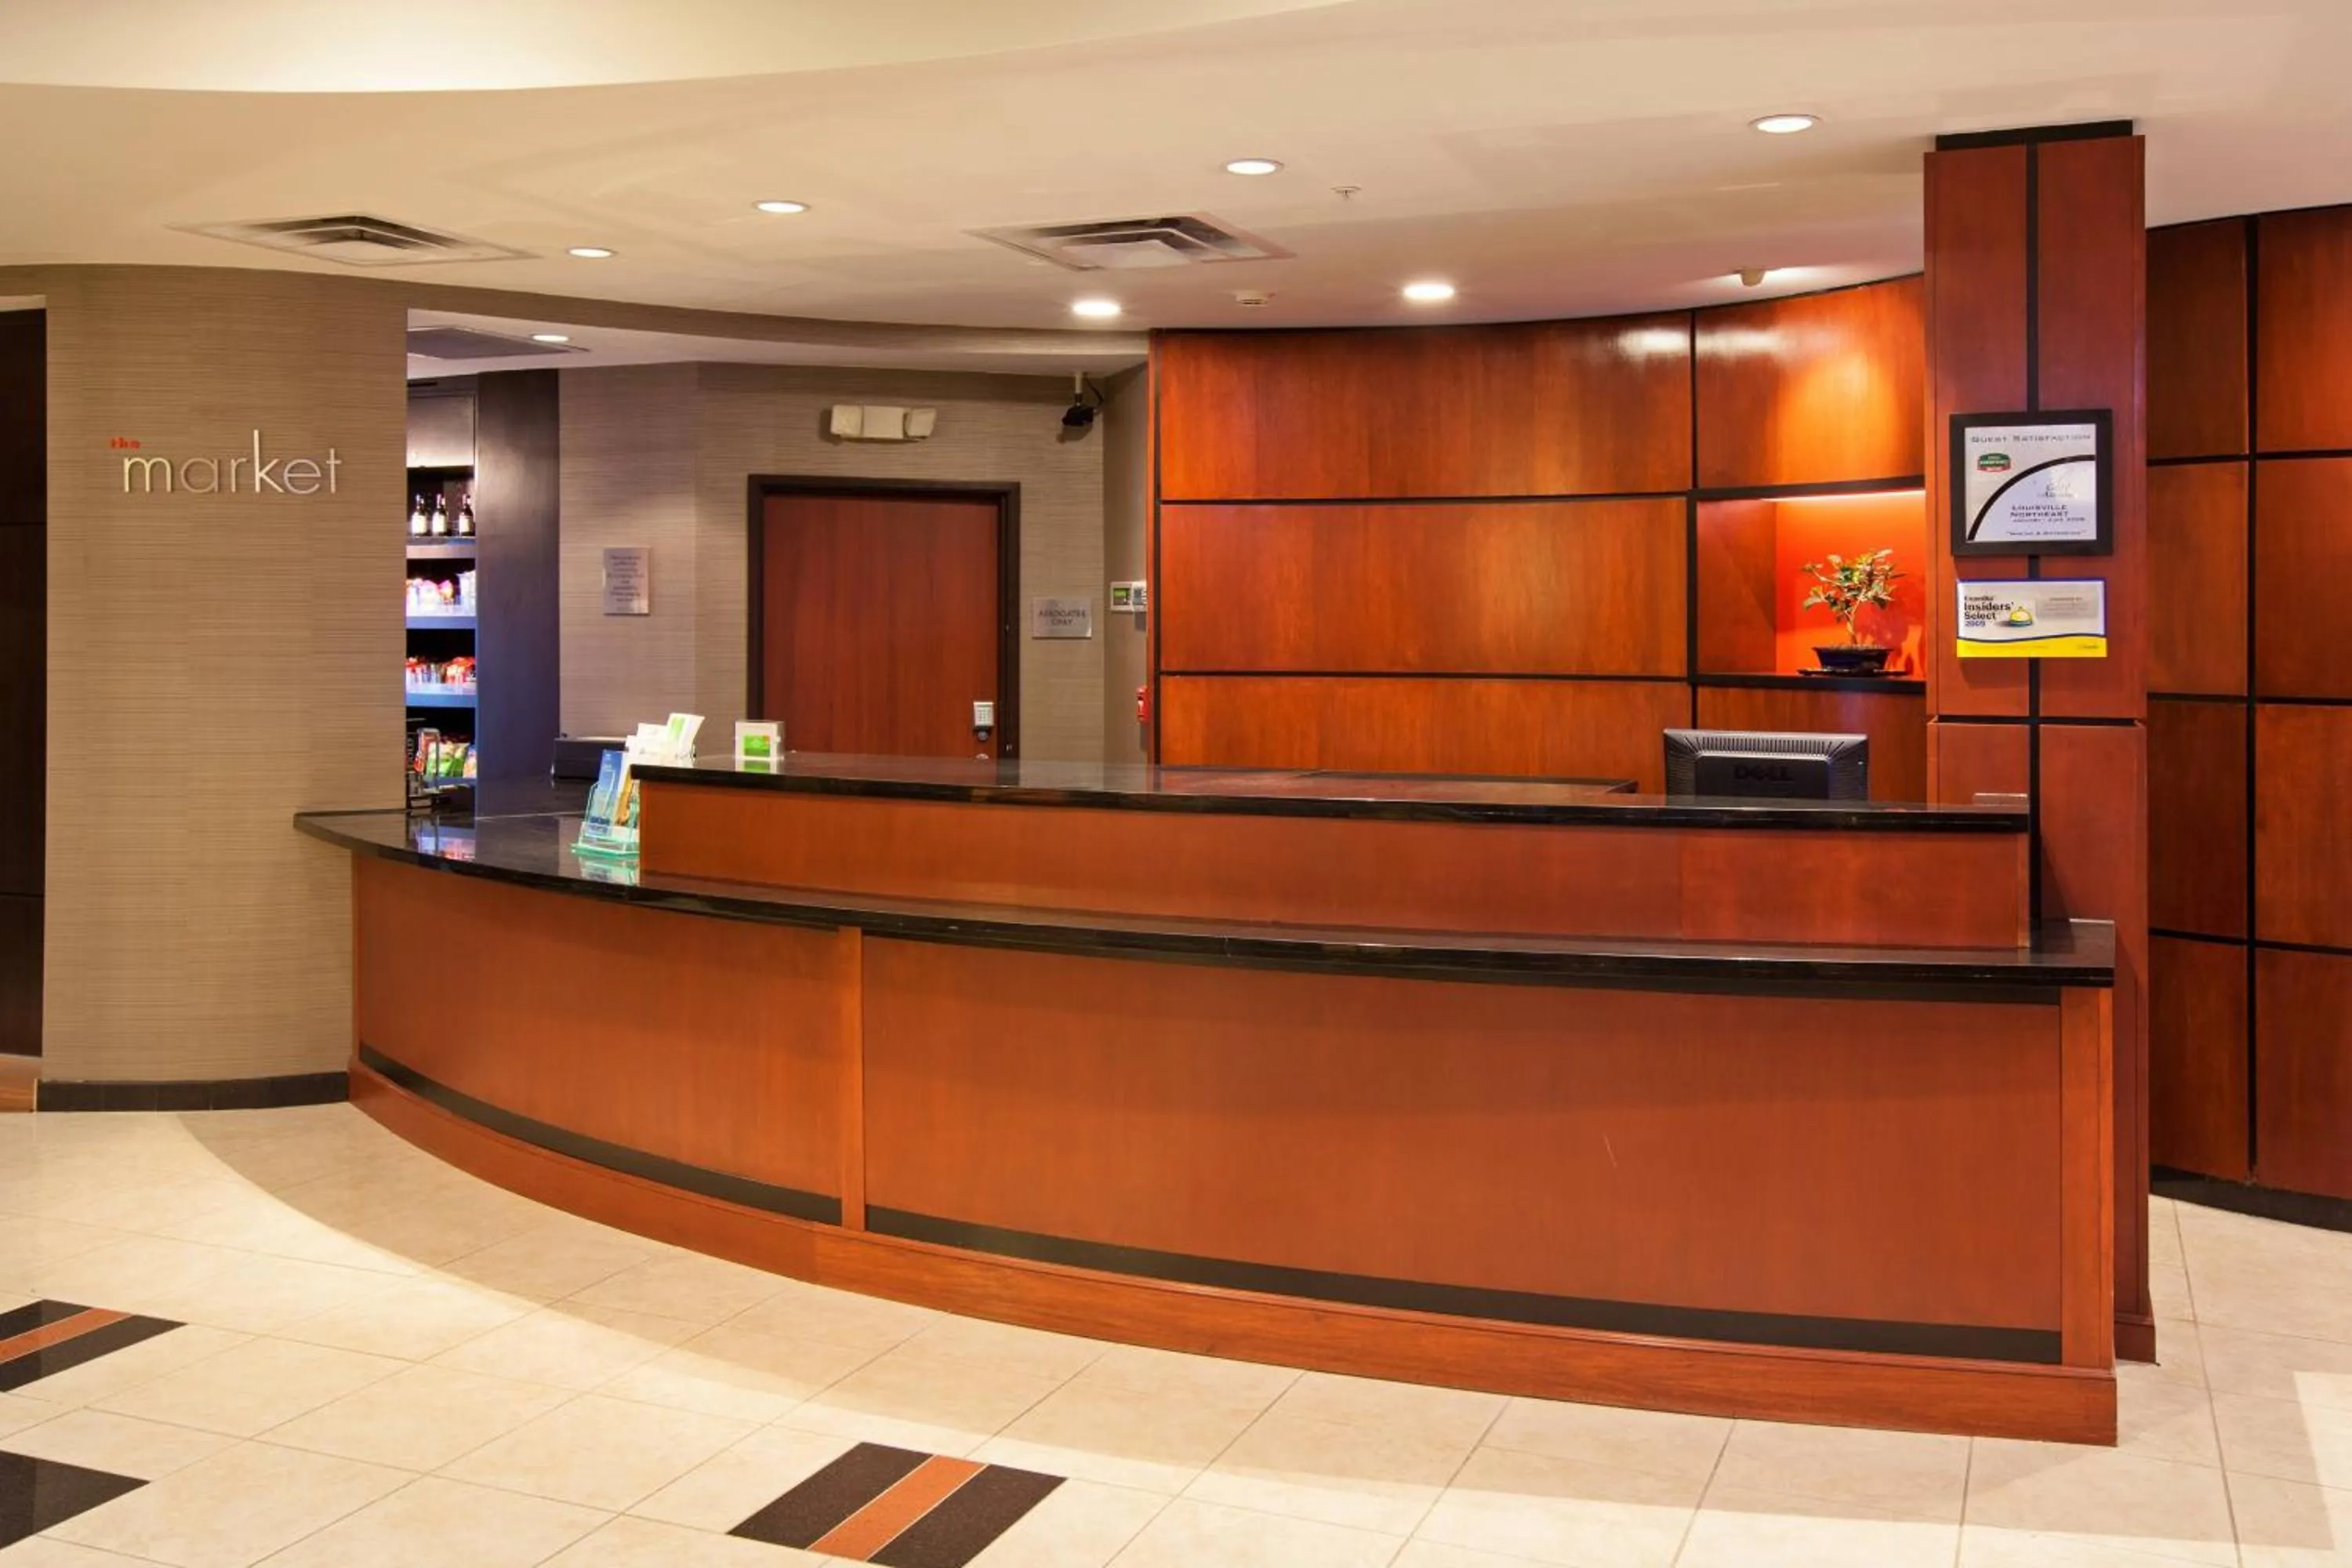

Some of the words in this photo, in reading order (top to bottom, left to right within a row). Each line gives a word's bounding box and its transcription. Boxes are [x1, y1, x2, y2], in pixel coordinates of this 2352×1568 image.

[111, 437, 140, 449] the
[123, 429, 343, 494] market
[1964, 601, 2014, 611] Insiders'
[1964, 612, 1996, 620] Select
[1733, 764, 1794, 782] DELL
